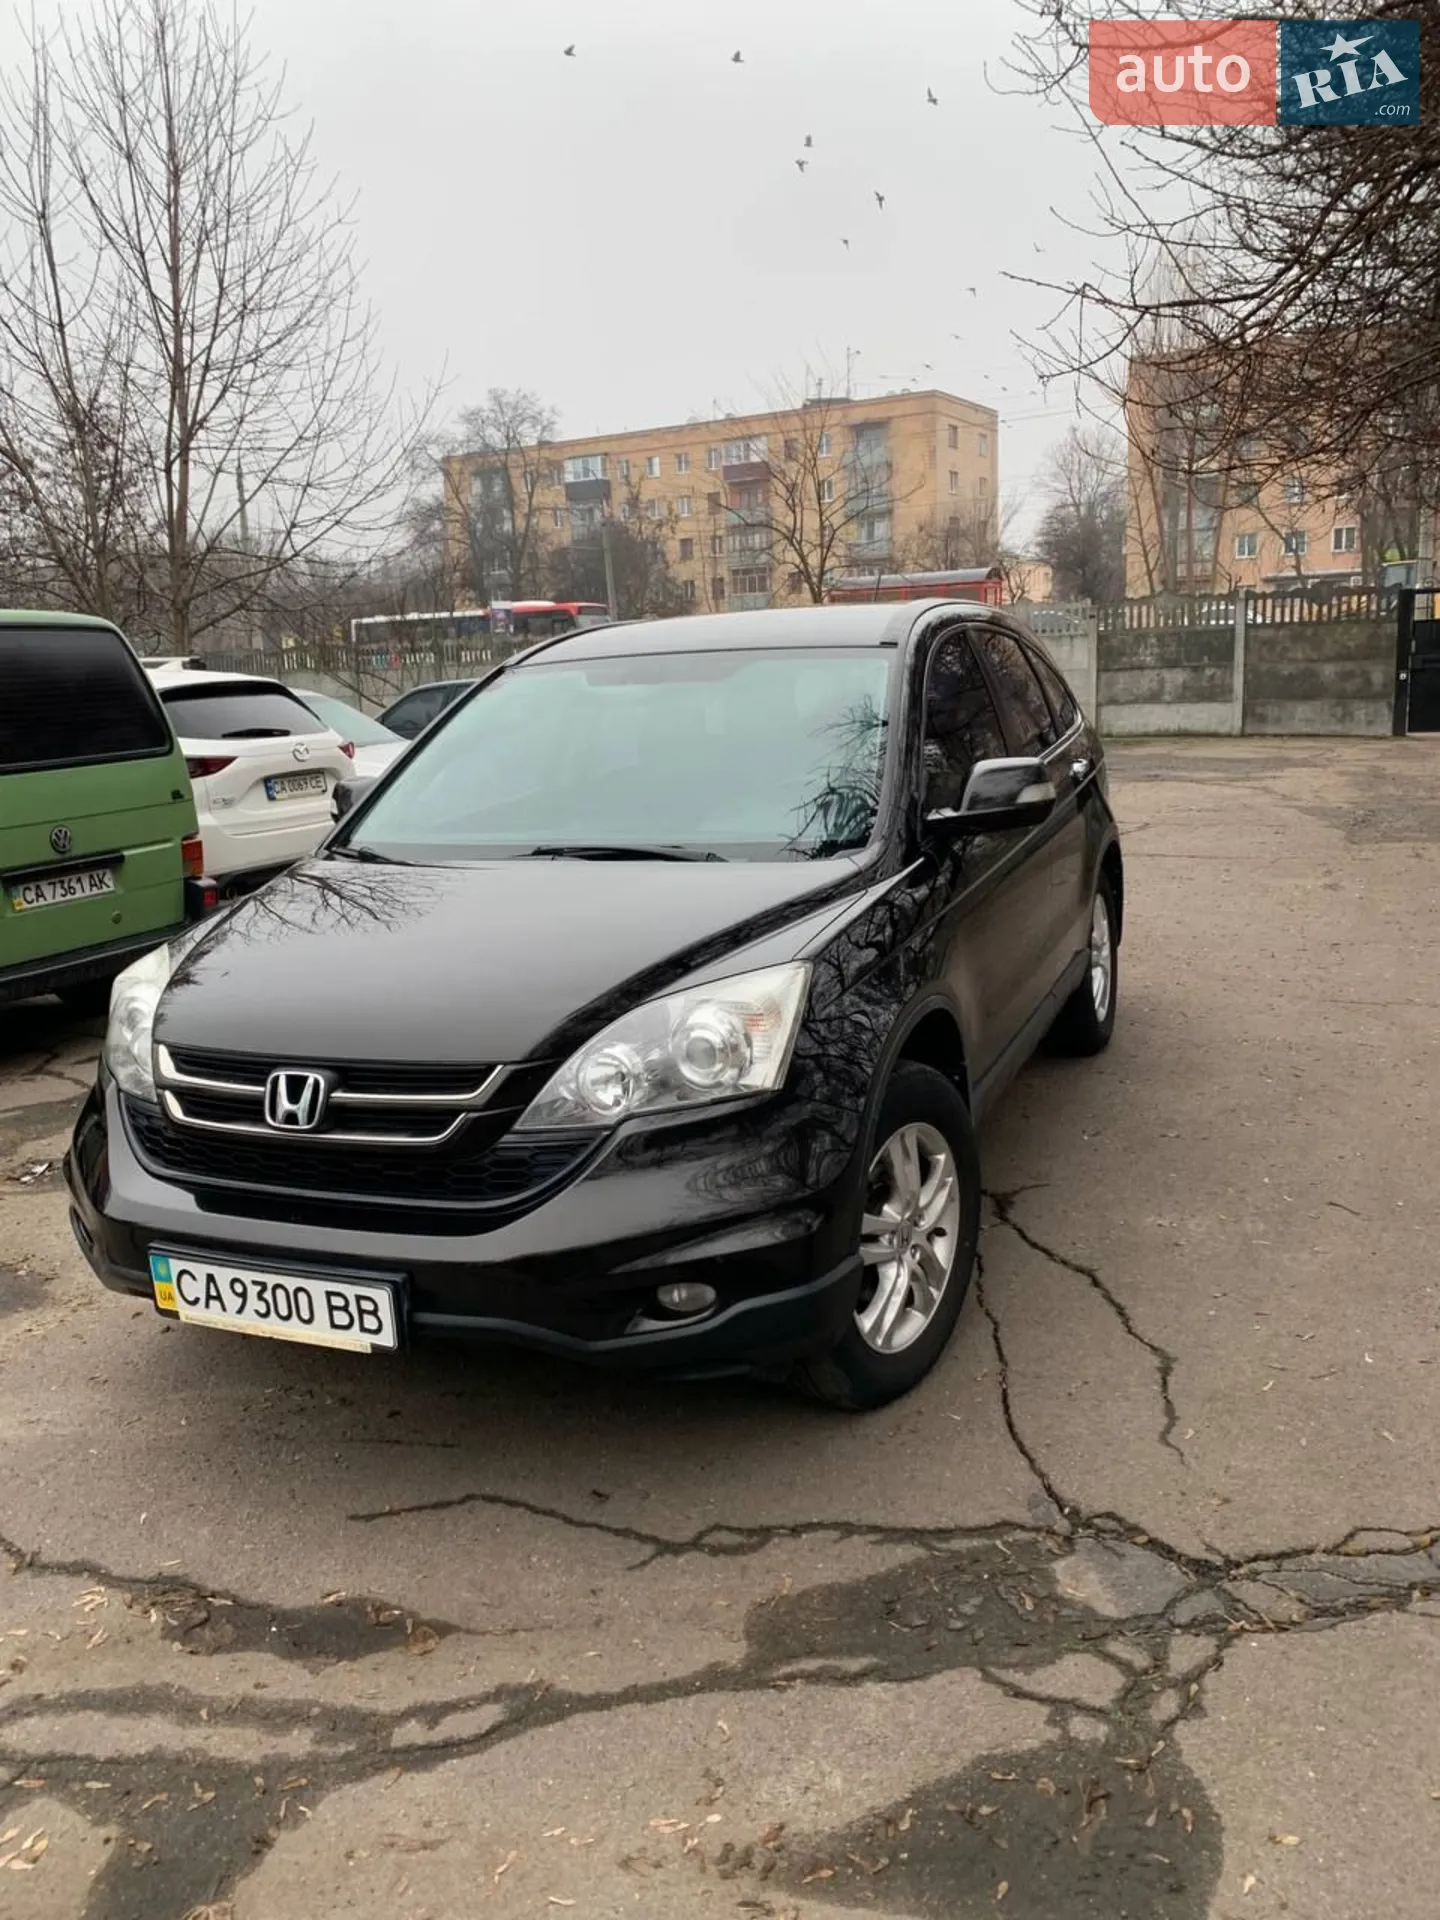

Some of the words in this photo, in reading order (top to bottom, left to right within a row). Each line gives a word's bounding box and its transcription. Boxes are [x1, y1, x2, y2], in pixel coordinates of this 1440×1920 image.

[22, 884, 47, 905] CA
[48, 877, 86, 900] 7361
[89, 871, 111, 893] AK
[160, 1290, 174, 1302] UA
[325, 1290, 384, 1336] BB
